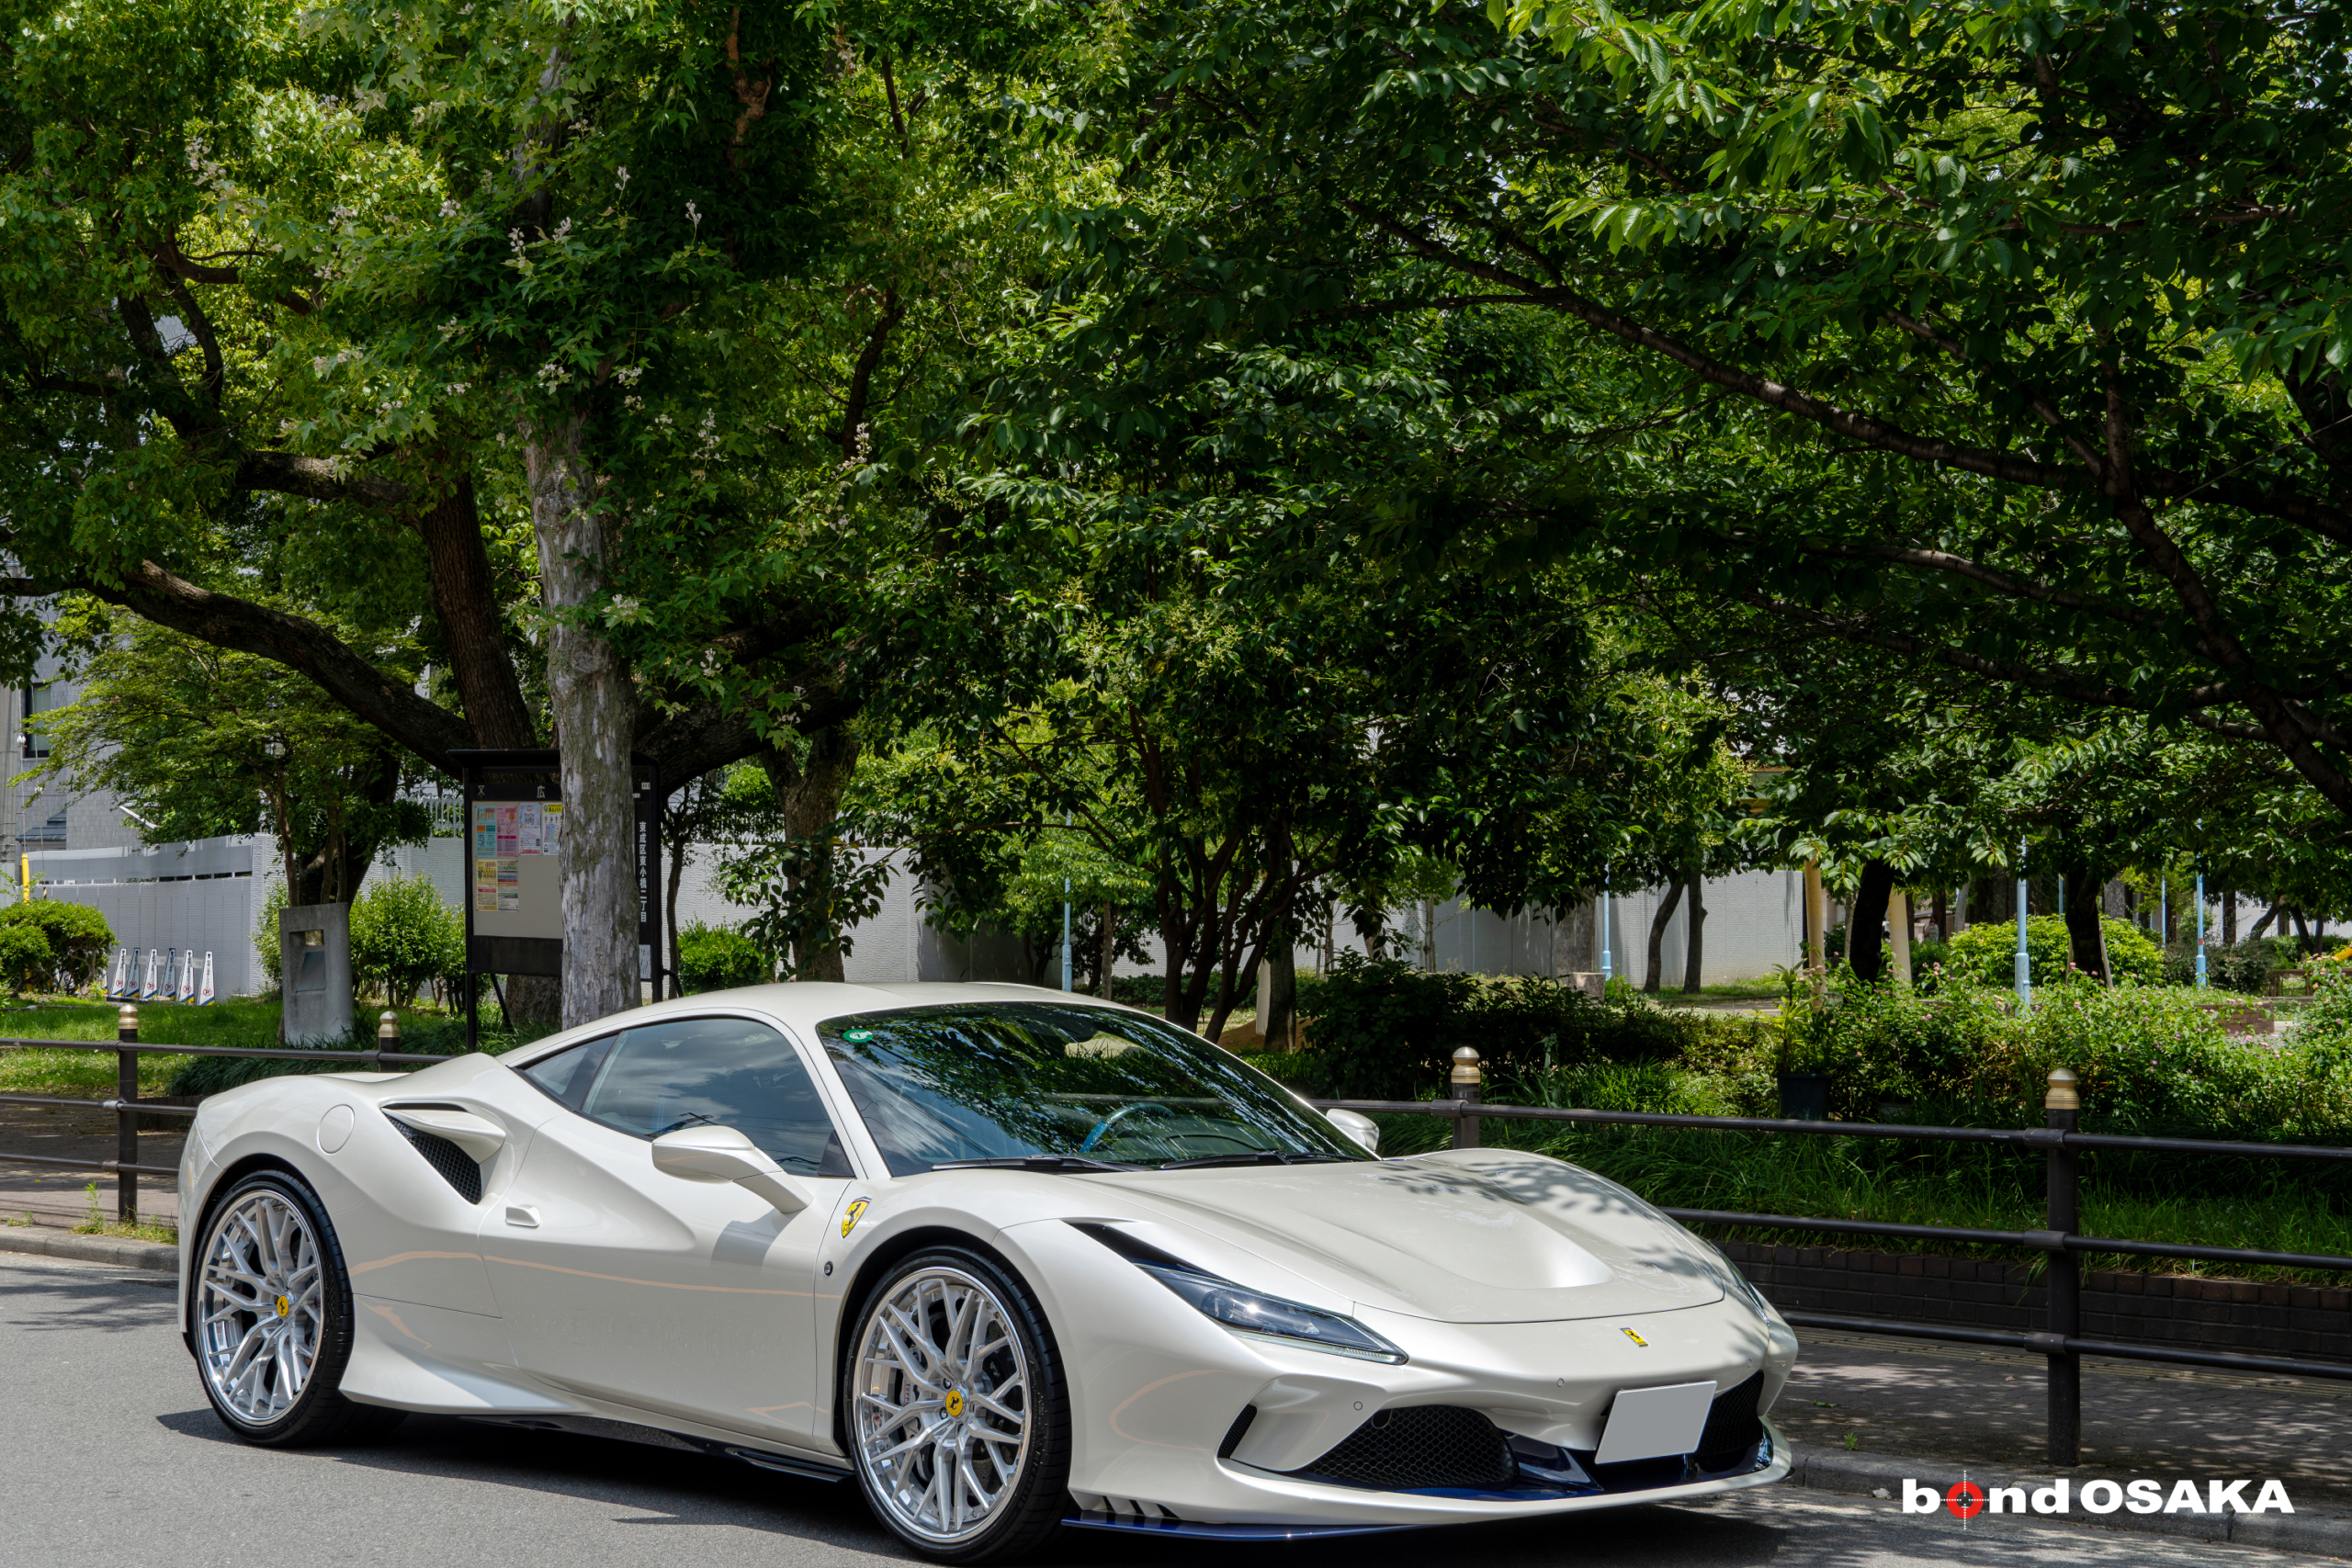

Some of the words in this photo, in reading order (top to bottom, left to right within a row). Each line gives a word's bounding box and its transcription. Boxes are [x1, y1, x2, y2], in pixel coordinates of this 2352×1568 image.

[639, 821, 647, 922] 東成区東小橋二丁目
